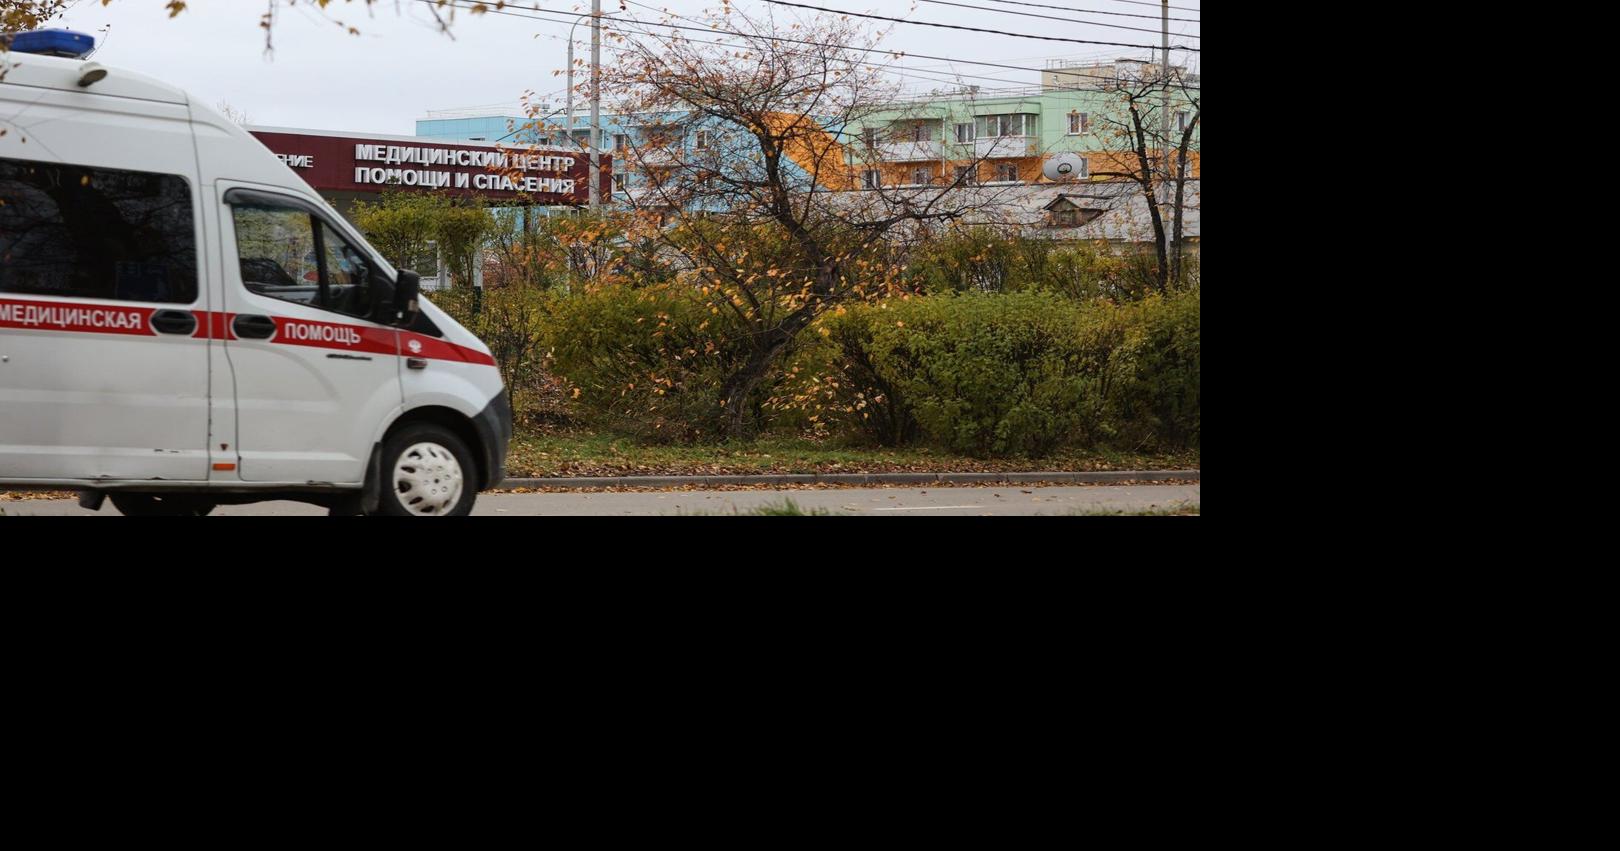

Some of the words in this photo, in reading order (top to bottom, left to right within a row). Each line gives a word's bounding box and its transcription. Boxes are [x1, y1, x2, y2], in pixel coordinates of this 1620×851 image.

[355, 143, 509, 170] МЕДИЦИНСКИЙ
[512, 153, 575, 172] ЦЕНТР
[355, 167, 450, 189] ПОМОЩИ
[455, 171, 469, 189] И
[473, 173, 575, 194] СПАСЕНИЯ
[0, 303, 143, 329] МЕДИЦИНСКАЯ
[284, 322, 361, 345] ПОМОЩЬ
